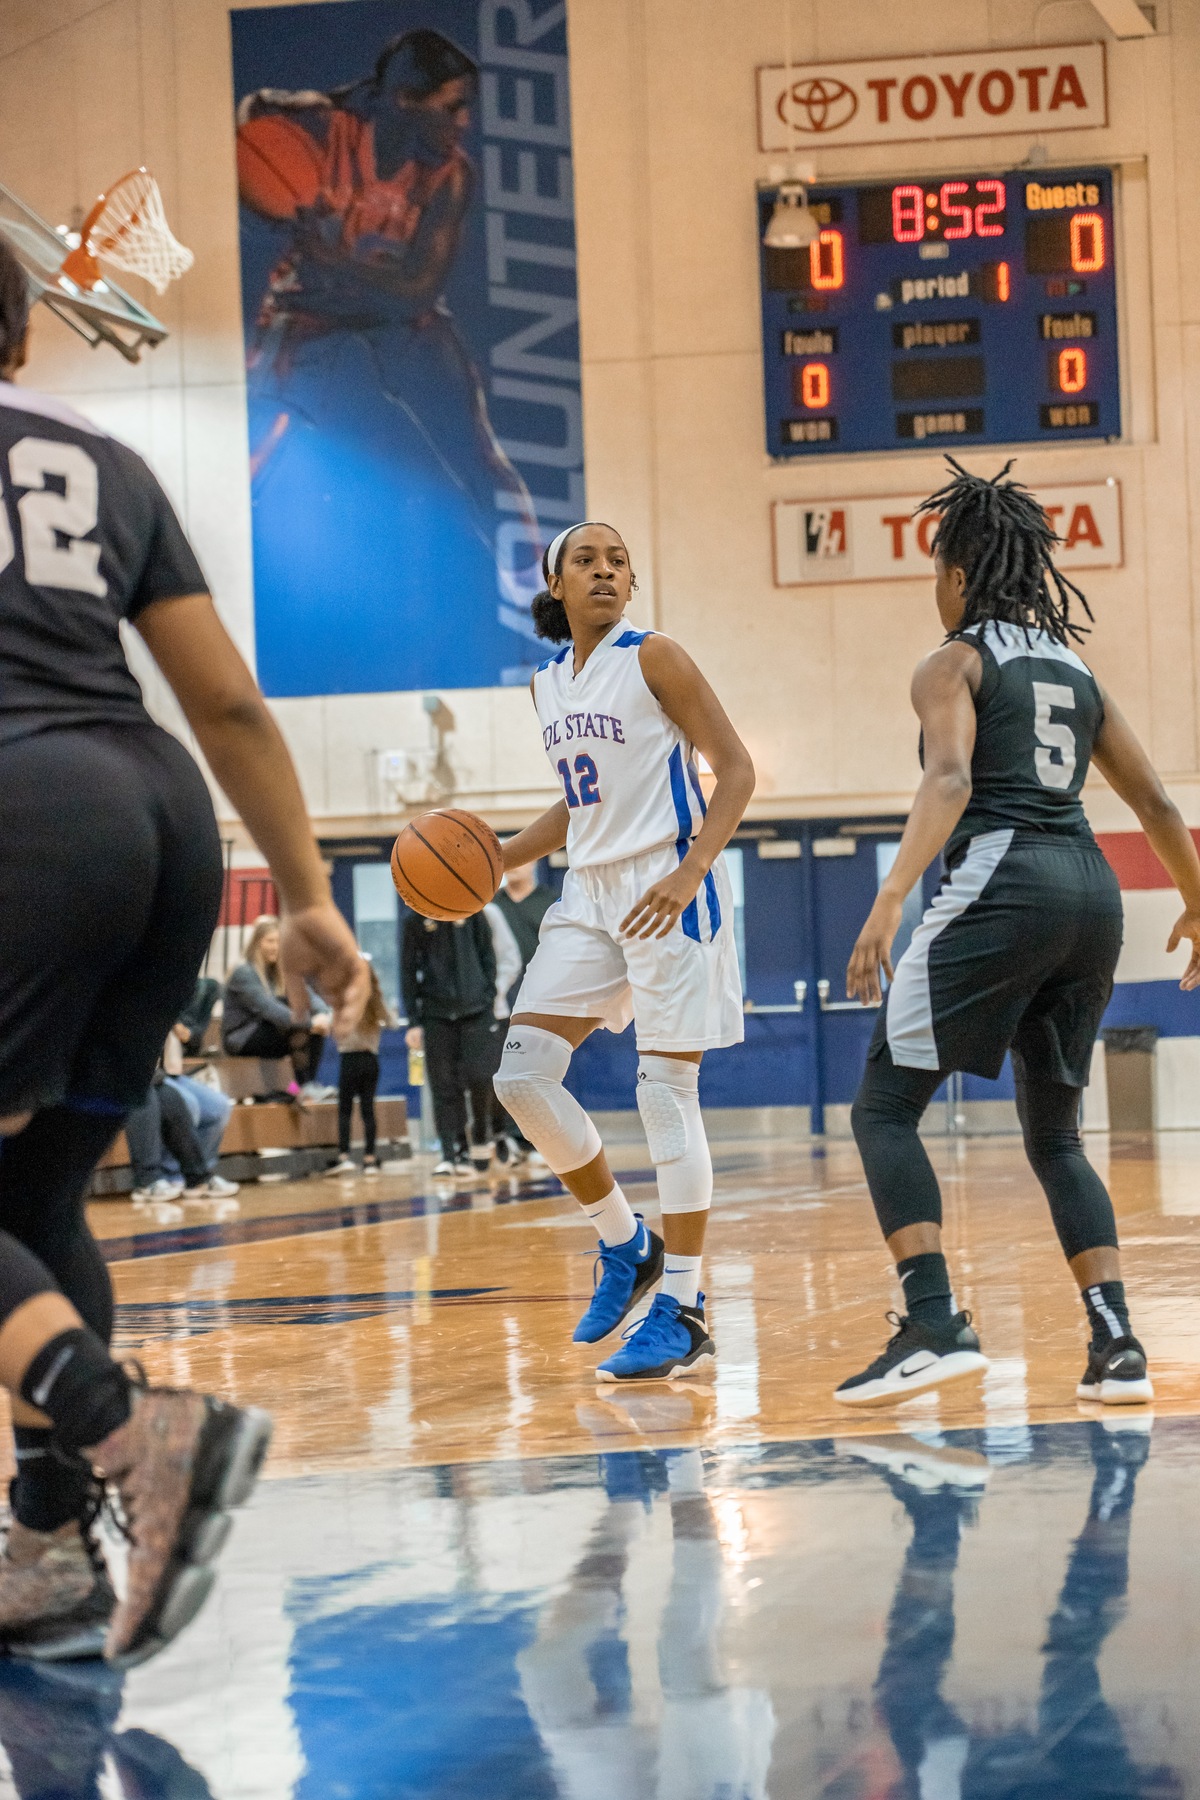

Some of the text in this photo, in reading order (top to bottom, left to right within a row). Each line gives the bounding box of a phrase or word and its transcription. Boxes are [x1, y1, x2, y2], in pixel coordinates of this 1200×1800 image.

[867, 64, 1088, 123] TOYOTA
[892, 180, 1006, 242] 8:52
[1025, 182, 1099, 210] Guests
[811, 230, 844, 290] 0
[1069, 213, 1105, 272] 0
[901, 261, 1010, 304] period 1
[802, 363, 830, 409] 0
[1059, 347, 1087, 393] 0
[0, 437, 107, 597] 2
[543, 712, 626, 751] OL STATE
[1032, 681, 1076, 790] 5
[557, 752, 602, 809] 12
